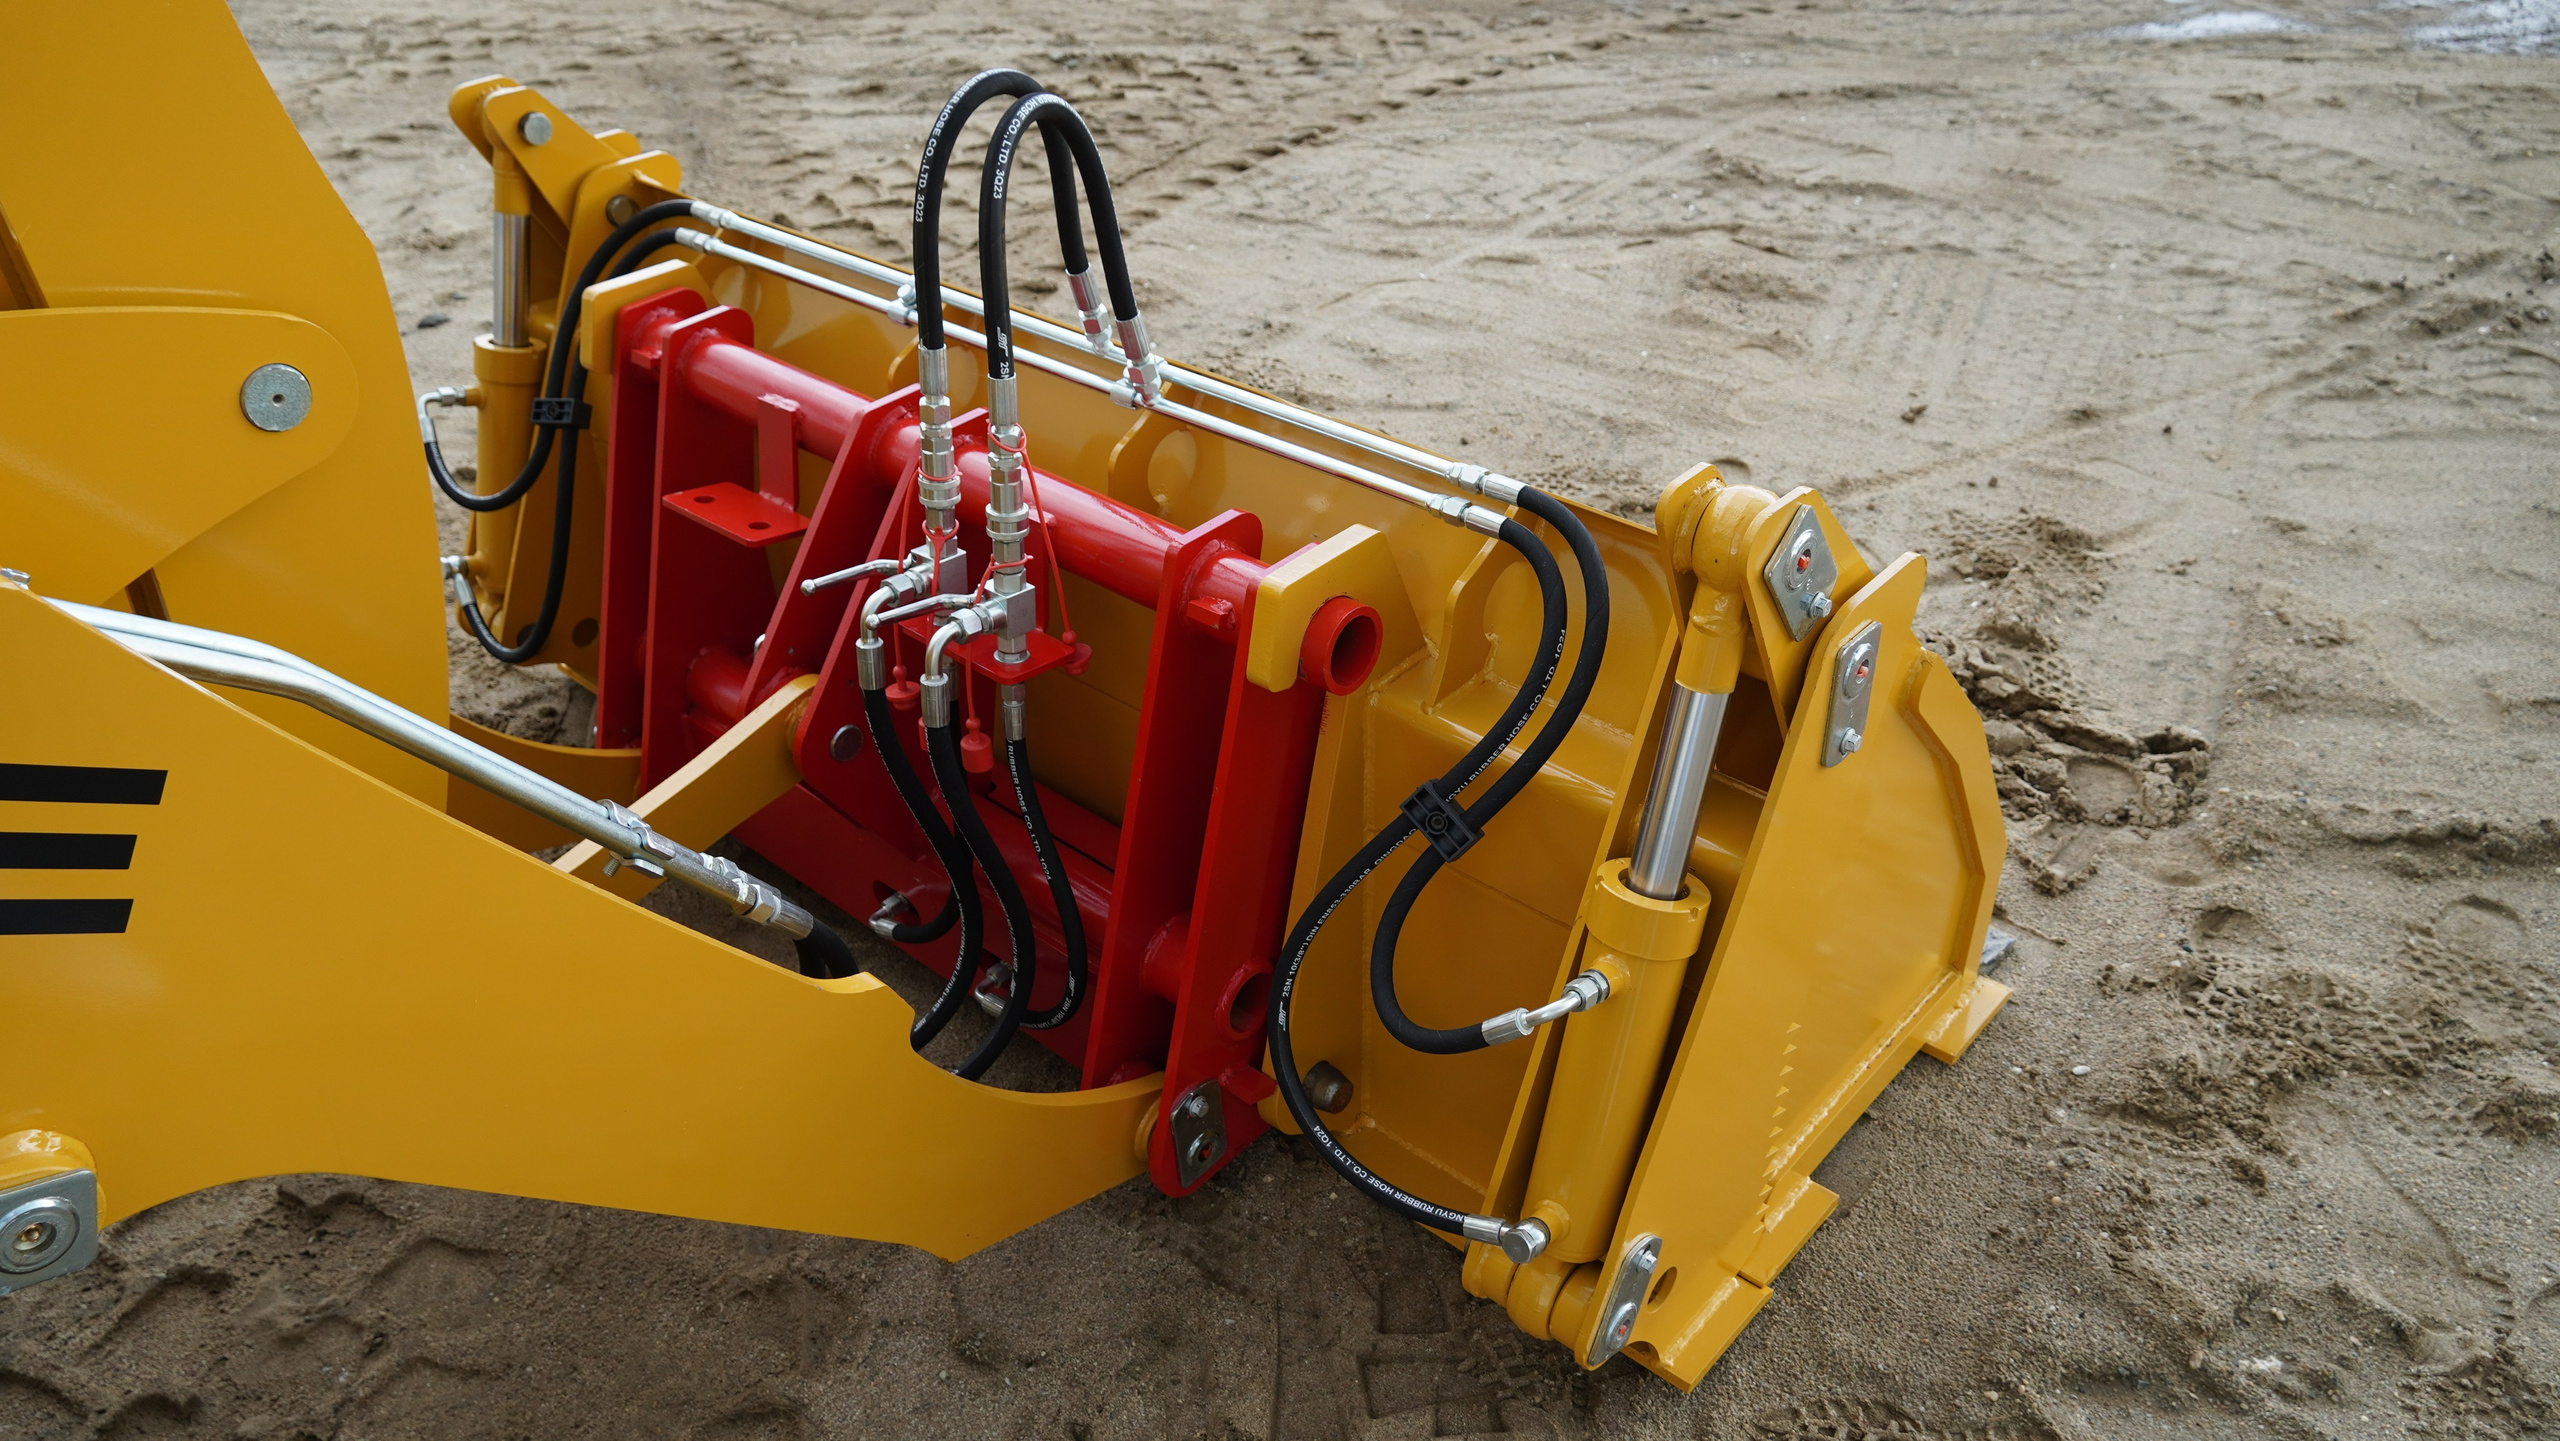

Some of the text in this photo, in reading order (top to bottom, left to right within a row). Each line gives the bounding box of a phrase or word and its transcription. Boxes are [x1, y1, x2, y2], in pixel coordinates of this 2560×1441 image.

[932, 104, 954, 137] HOSE
[1016, 97, 1038, 120] HOSE
[993, 168, 1005, 199] 3Q23
[915, 194, 925, 223] 3Q23
[1469, 743, 1507, 781] RUBBER
[1506, 712, 1531, 742] HOSE
[1008, 744, 1019, 785] RUBBER
[1015, 786, 1028, 813] HOSE
[1282, 978, 1293, 998] 2SN
[1306, 925, 1320, 942] DIN
[1374, 828, 1417, 866] QINGDAO
[1313, 1125, 1333, 1148] 1Q24
[1367, 1175, 1394, 1195] HOSE
[1394, 1190, 1434, 1213] RUBBER
